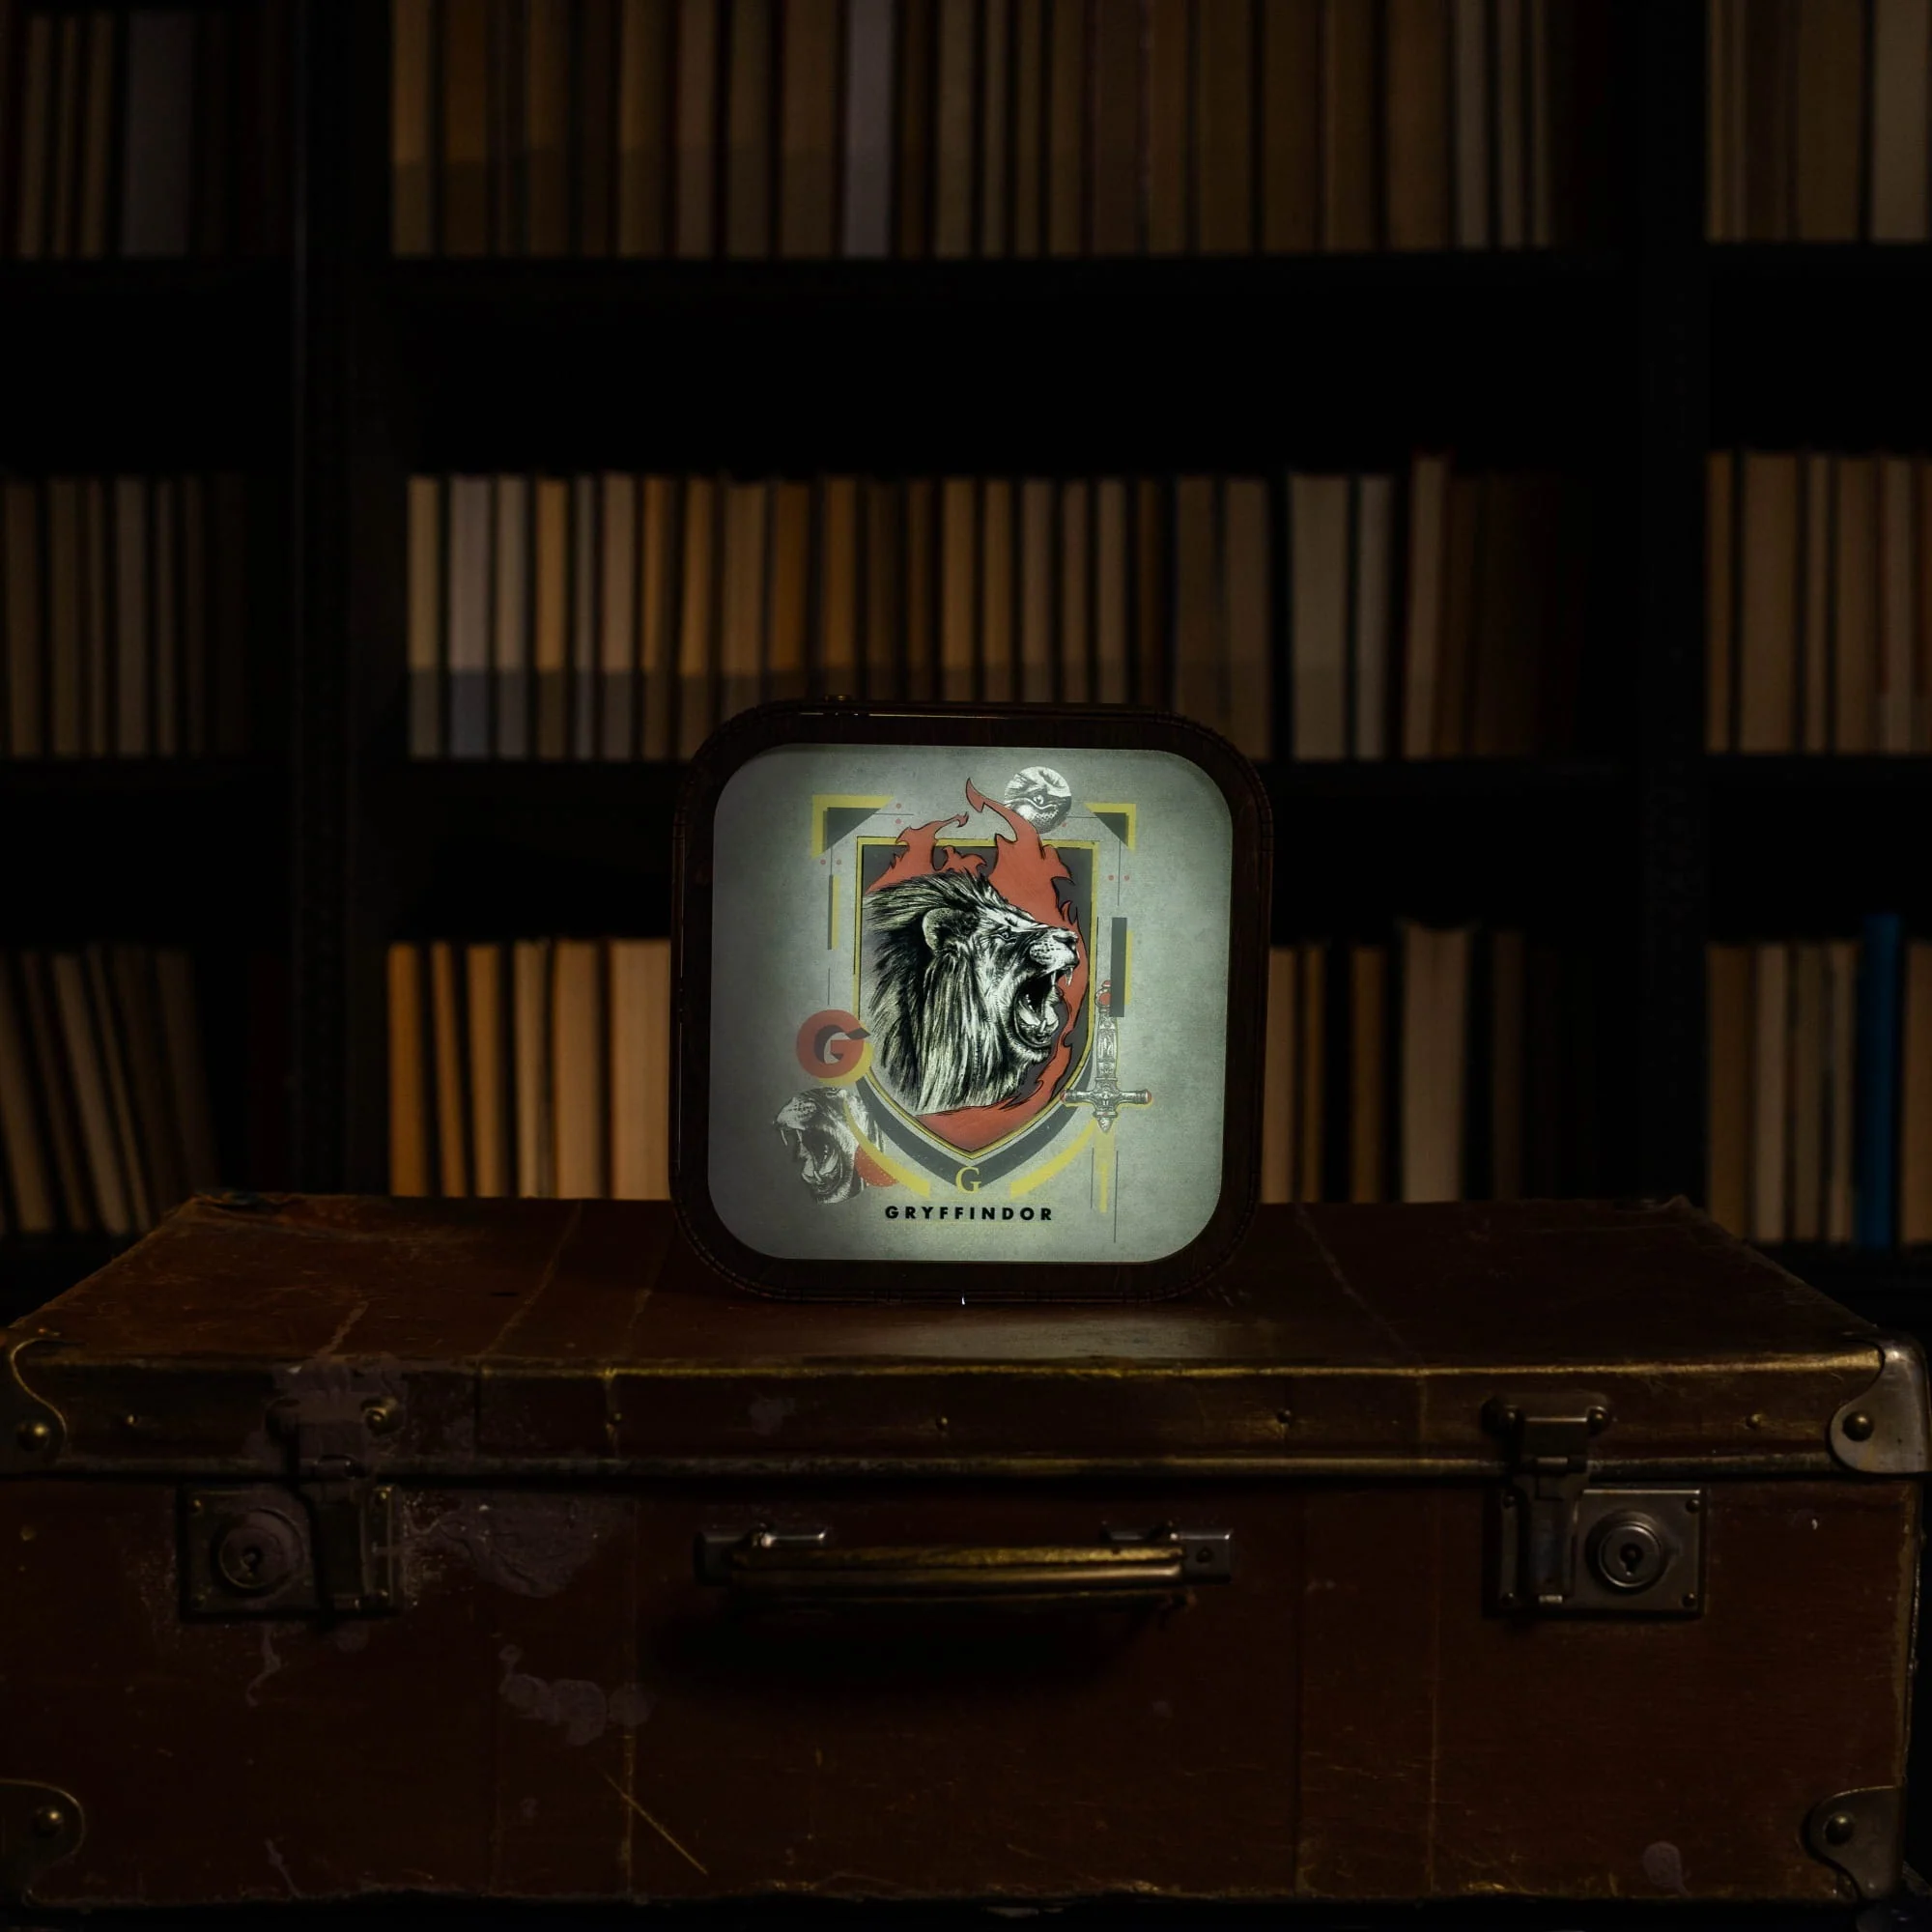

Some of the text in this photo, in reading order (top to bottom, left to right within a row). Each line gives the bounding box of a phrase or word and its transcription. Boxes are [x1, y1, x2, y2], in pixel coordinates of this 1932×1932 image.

[796, 1009, 870, 1078] G
[955, 1166, 981, 1194] G
[885, 1206, 1052, 1221] GRYFFINDOR
